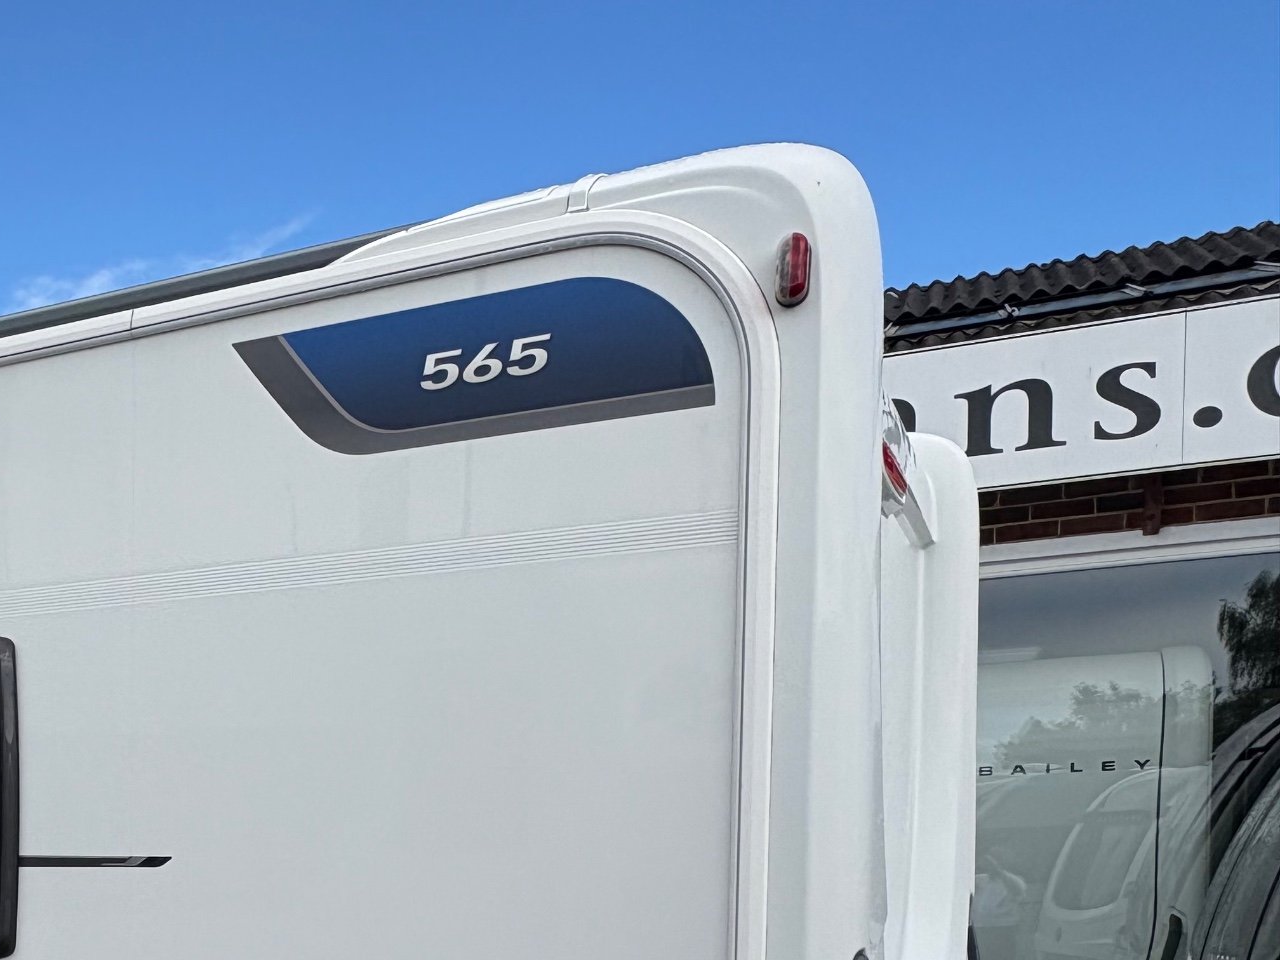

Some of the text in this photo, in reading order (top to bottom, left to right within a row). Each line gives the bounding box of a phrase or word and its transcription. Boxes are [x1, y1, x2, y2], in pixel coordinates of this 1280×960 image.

[420, 333, 552, 391] 565
[890, 345, 1280, 458] ns.
[978, 759, 1151, 776] BAILEY
